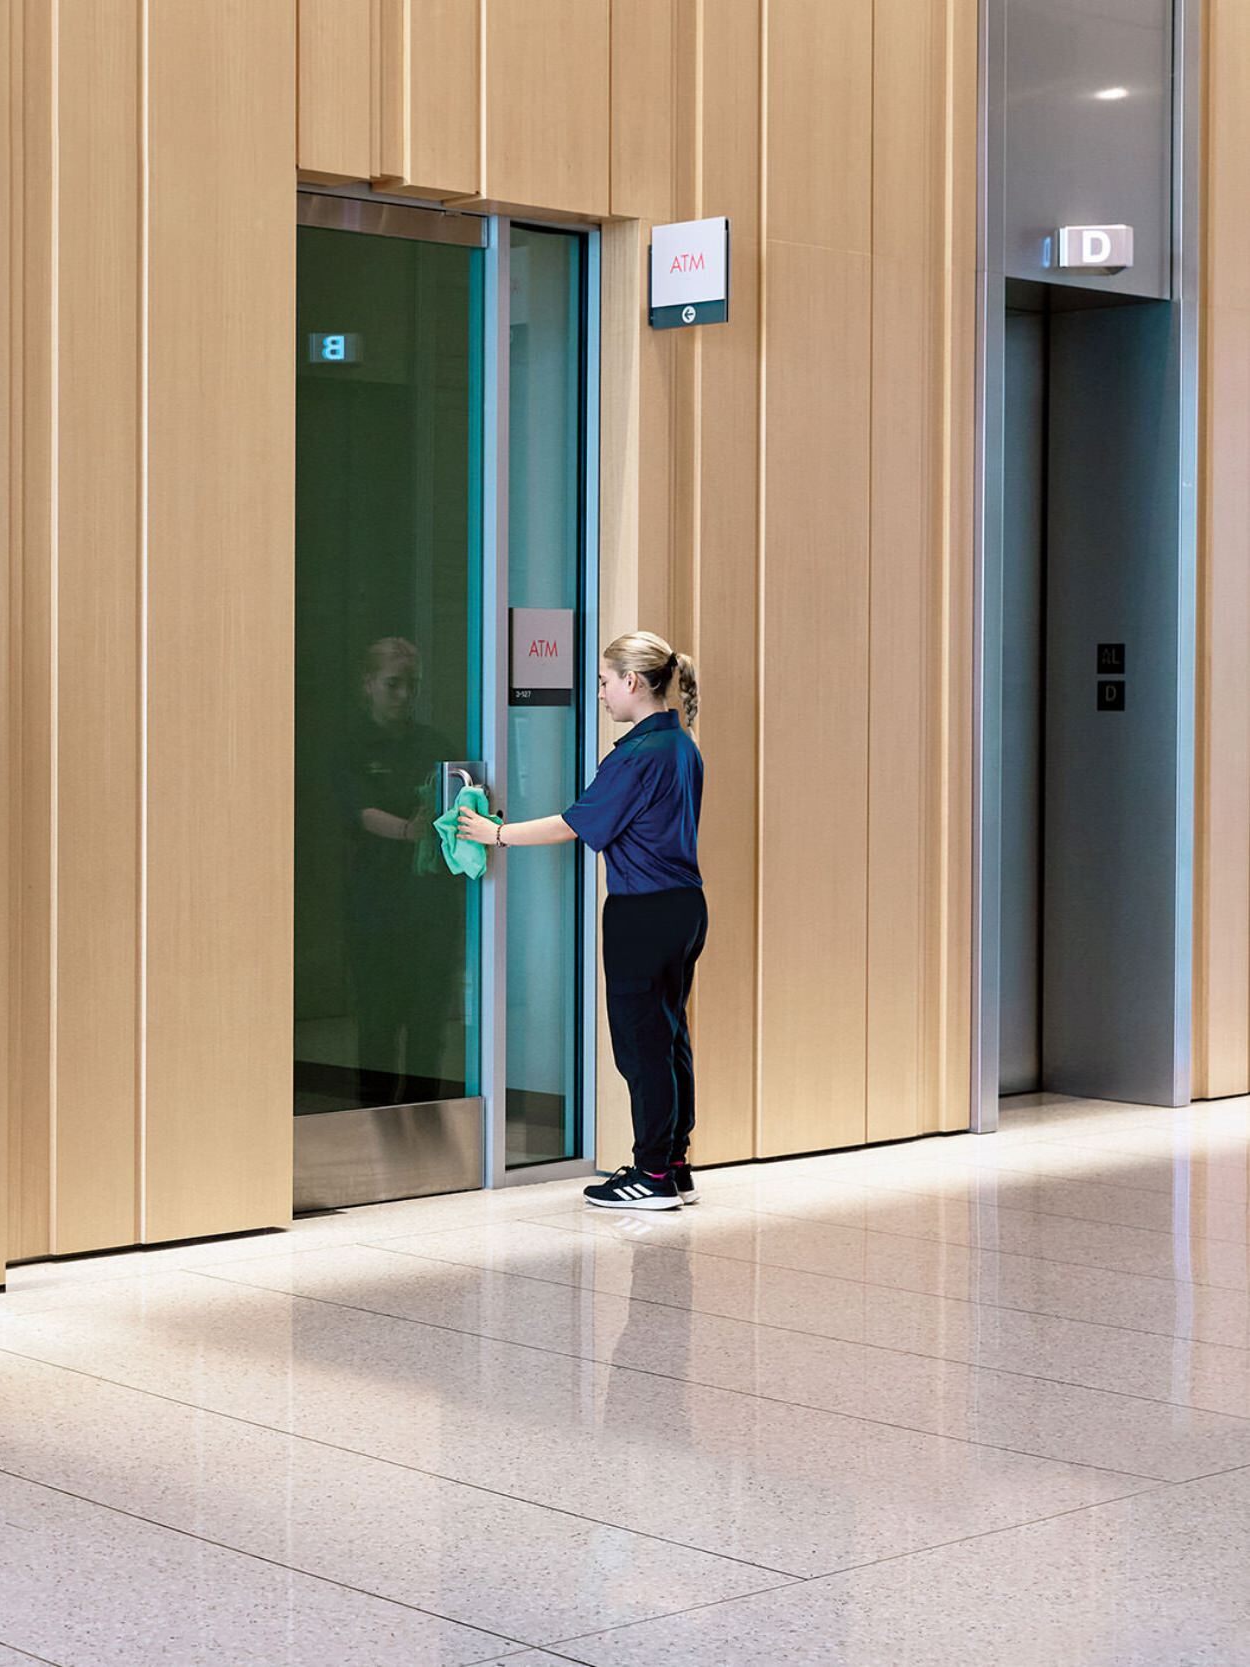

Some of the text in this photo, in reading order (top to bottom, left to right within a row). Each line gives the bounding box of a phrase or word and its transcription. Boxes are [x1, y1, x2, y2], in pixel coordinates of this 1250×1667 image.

[1082, 230, 1111, 263] D
[669, 253, 705, 274] ATM
[528, 639, 559, 657] ATM
[1105, 685, 1117, 702] D
